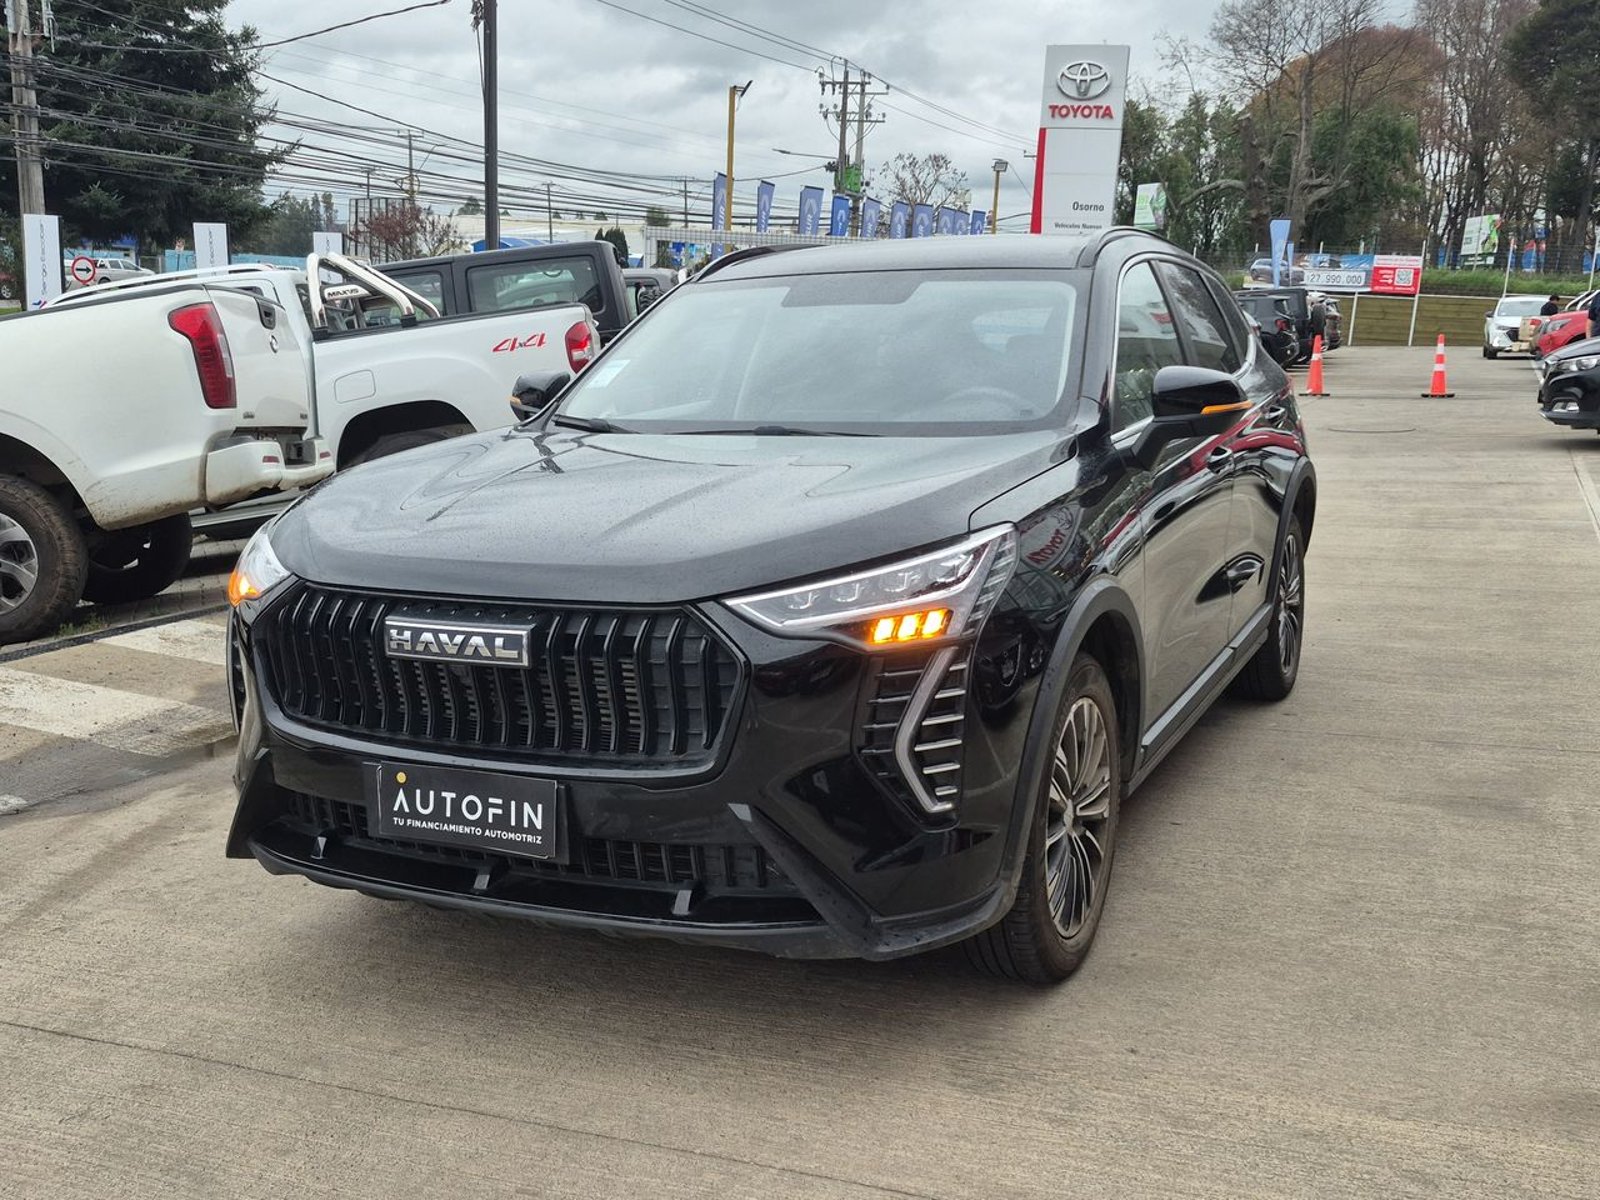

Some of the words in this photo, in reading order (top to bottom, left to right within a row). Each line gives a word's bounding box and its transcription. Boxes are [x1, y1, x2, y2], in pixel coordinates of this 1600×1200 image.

[1048, 104, 1114, 119] TOYOTA
[1072, 201, 1105, 212] Osorno
[389, 629, 519, 658] HAVAL
[393, 787, 543, 830] AUTOFIN
[393, 817, 405, 826] TU
[406, 819, 482, 836] FINANCIAMIENTO
[484, 829, 543, 845] AUTOMOTRIZ
